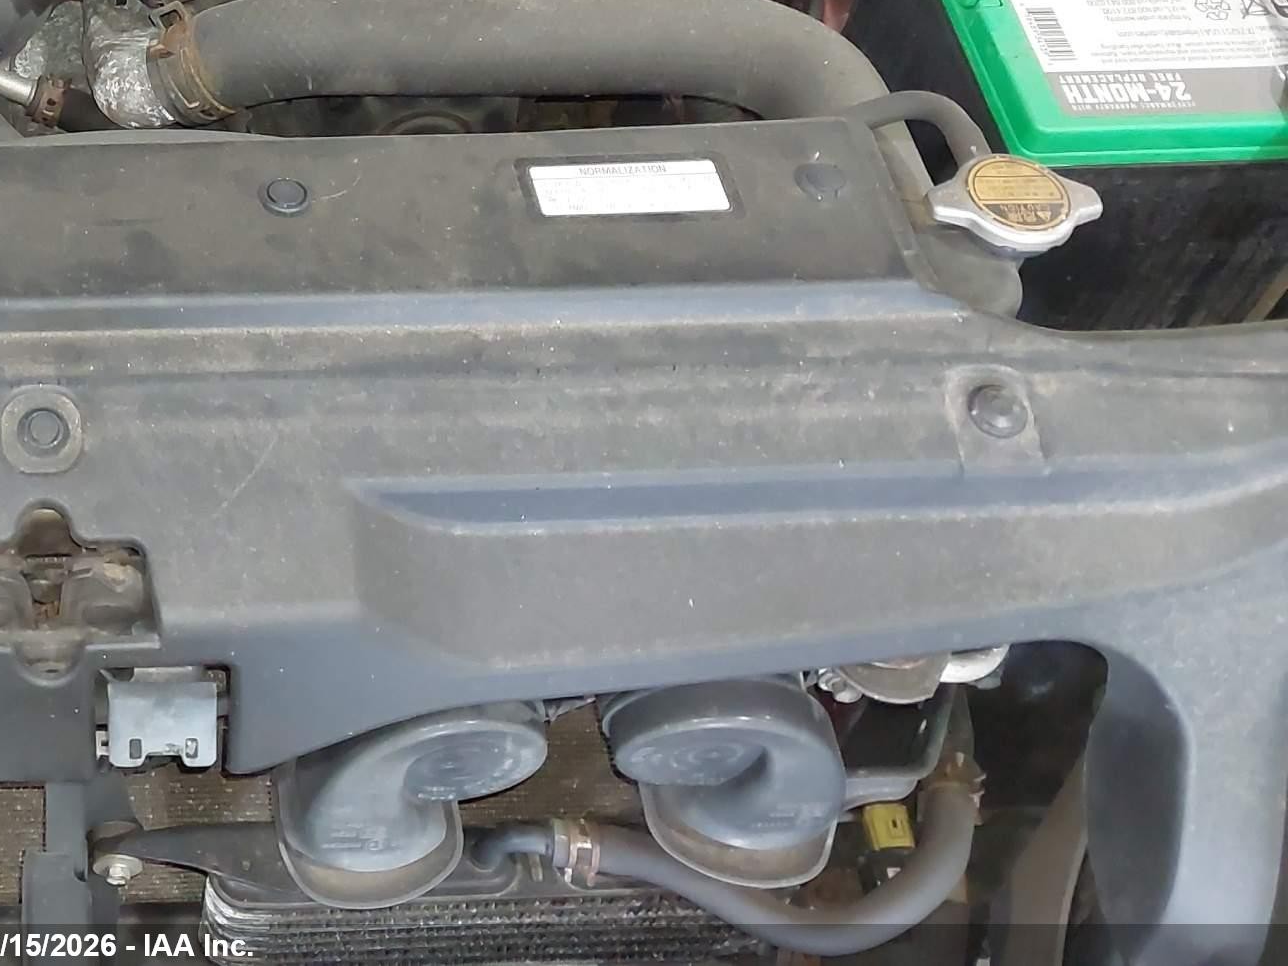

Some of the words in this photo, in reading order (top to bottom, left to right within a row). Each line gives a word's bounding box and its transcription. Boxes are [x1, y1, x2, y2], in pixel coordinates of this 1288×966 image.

[1058, 73, 1147, 84] REPLACEMENT
[1062, 81, 1192, 104] 24-MONTH
[578, 163, 667, 176] NORMALIZATION
